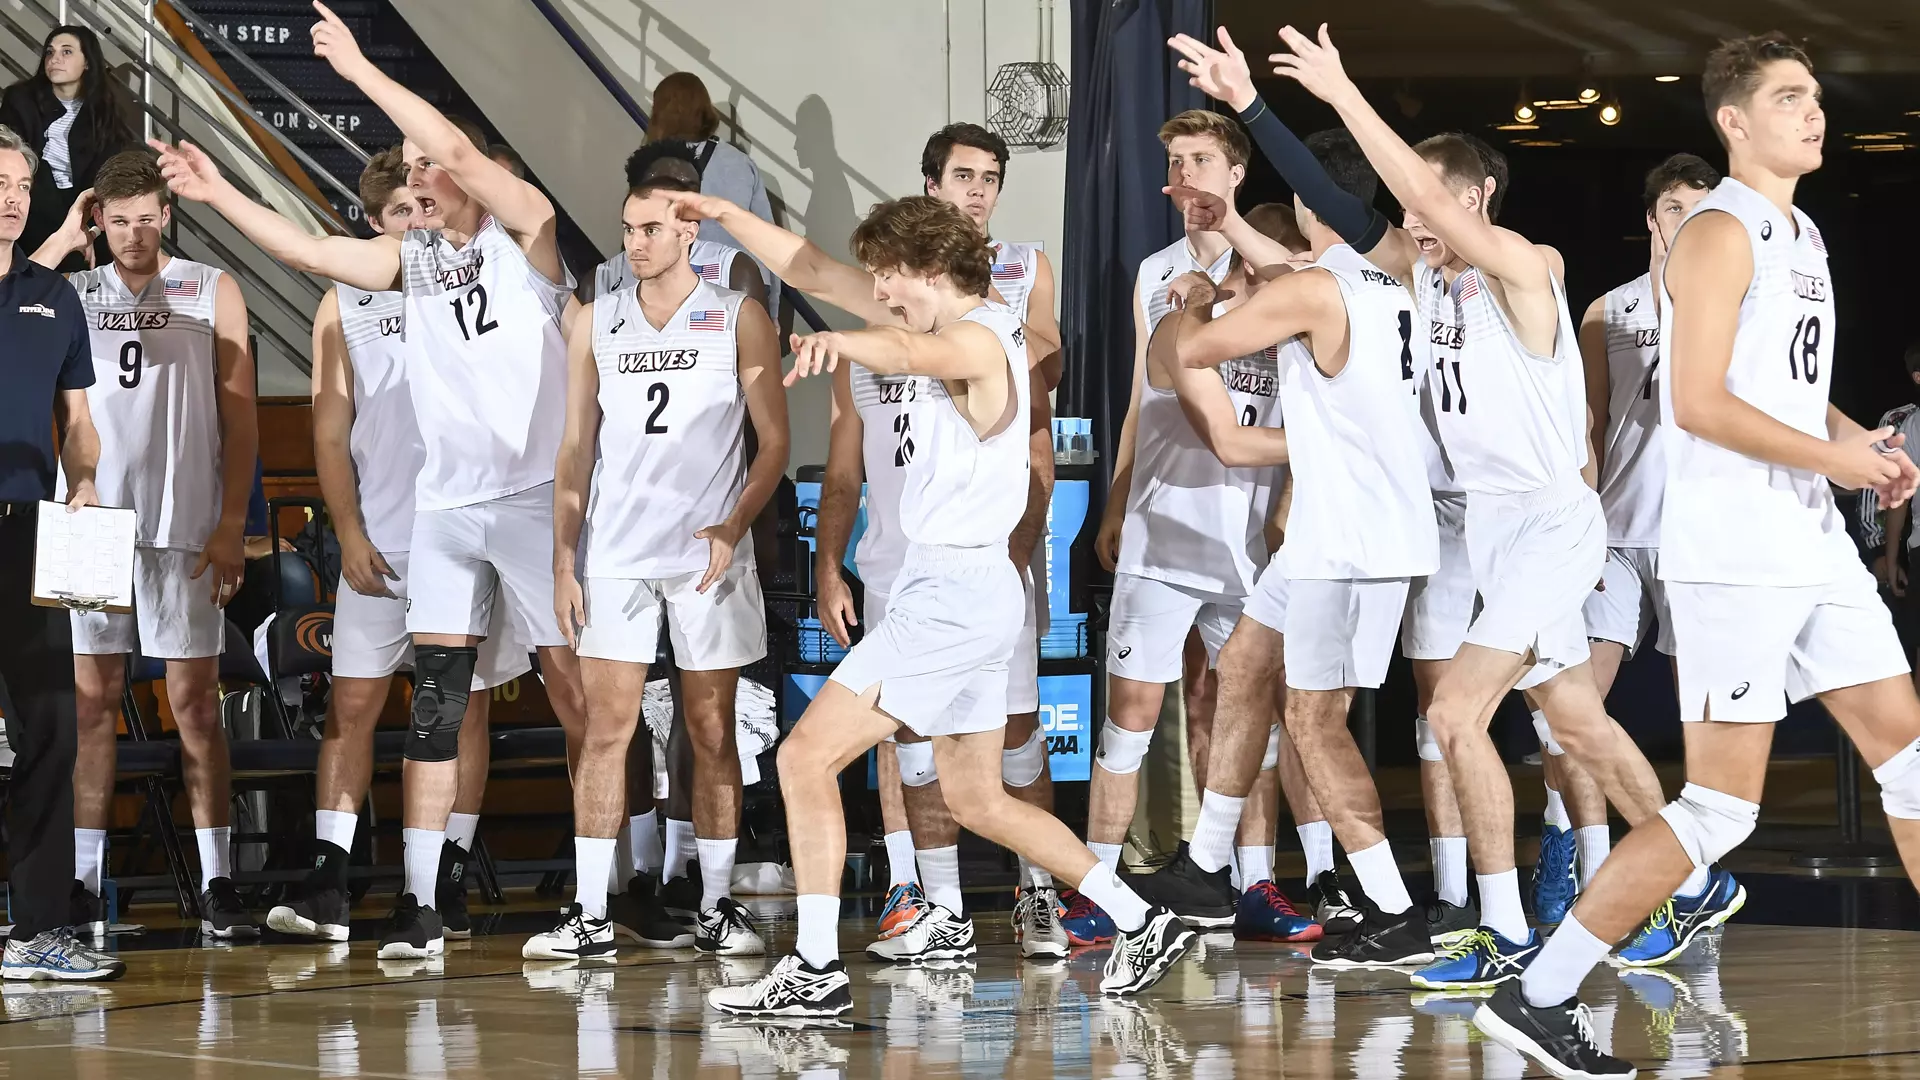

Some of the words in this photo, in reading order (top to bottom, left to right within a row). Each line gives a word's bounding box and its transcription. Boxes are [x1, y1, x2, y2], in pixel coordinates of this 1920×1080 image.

[237, 24, 291, 44] STEP
[273, 111, 299, 129] ON
[98, 311, 171, 331] WAVES
[449, 283, 499, 341] 12
[118, 340, 143, 389] 9
[617, 349, 699, 374] WAVES
[1789, 314, 1821, 385] 18
[1230, 369, 1273, 397] WAVES
[1435, 357, 1467, 415] 11
[645, 382, 670, 435] 2
